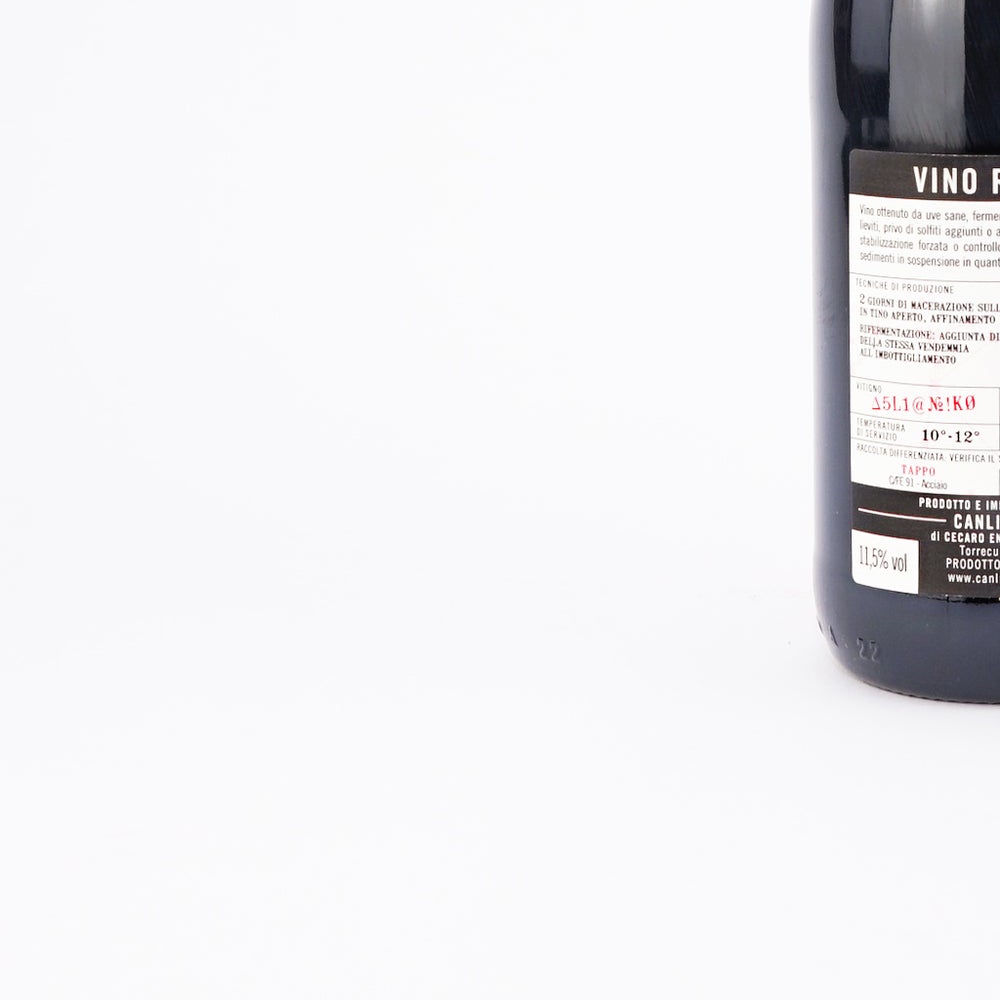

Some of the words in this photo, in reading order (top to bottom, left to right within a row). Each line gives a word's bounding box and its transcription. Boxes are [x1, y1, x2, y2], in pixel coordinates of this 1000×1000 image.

[913, 166, 977, 195] VINO
[860, 204, 875, 216] Vino
[877, 207, 909, 219] ottenuto
[912, 208, 922, 219] da
[926, 211, 941, 219] uve
[945, 211, 969, 222] sane,
[860, 219, 881, 233] lieviti,
[883, 222, 903, 234] privo
[906, 223, 914, 234] di
[917, 225, 941, 236] solfiti
[945, 226, 983, 238] aggiunti
[986, 228, 992, 236] o
[860, 236, 914, 249] stabilizzazione
[918, 239, 948, 251] forzata
[953, 242, 959, 251] o
[860, 251, 895, 263] sedimenti
[897, 254, 905, 264] in
[907, 256, 960, 267] sospensione
[963, 257, 972, 267] in
[856, 278, 889, 291] TECNICHE
[891, 282, 899, 292] DI
[902, 283, 955, 294] PRODUZIONE
[860, 294, 865, 304] 2
[867, 296, 895, 308] GIORNI
[898, 299, 907, 309] DI
[911, 301, 975, 312] MACERAZIONE
[860, 307, 868, 316] IN
[870, 308, 889, 319] TINO
[891, 311, 927, 323] APERTO,
[930, 314, 996, 324] AFFINAMENTO
[939, 332, 986, 341] AGGIUNTA
[989, 332, 1000, 341] DI
[884, 339, 914, 351] STESSA
[918, 342, 969, 353] VENDEMMIA
[856, 382, 882, 394] VITIGNO
[857, 417, 906, 433] TEMPERATURA
[857, 427, 864, 437] DI
[865, 430, 897, 442] SERVIZIO
[856, 443, 888, 456] RACCOLTA
[949, 454, 986, 463] VERIFICA
[988, 455, 996, 464] IL
[901, 464, 936, 477] TAPPO
[905, 477, 914, 487] 91
[921, 479, 948, 490] Acciaio
[919, 497, 971, 511] PRODOTTO
[975, 500, 981, 510] E
[930, 531, 940, 541] di
[944, 532, 985, 543] CECARO
[859, 545, 889, 570] 11,5%
[892, 553, 907, 572] vol
[945, 557, 1000, 570] PRODOTTO
